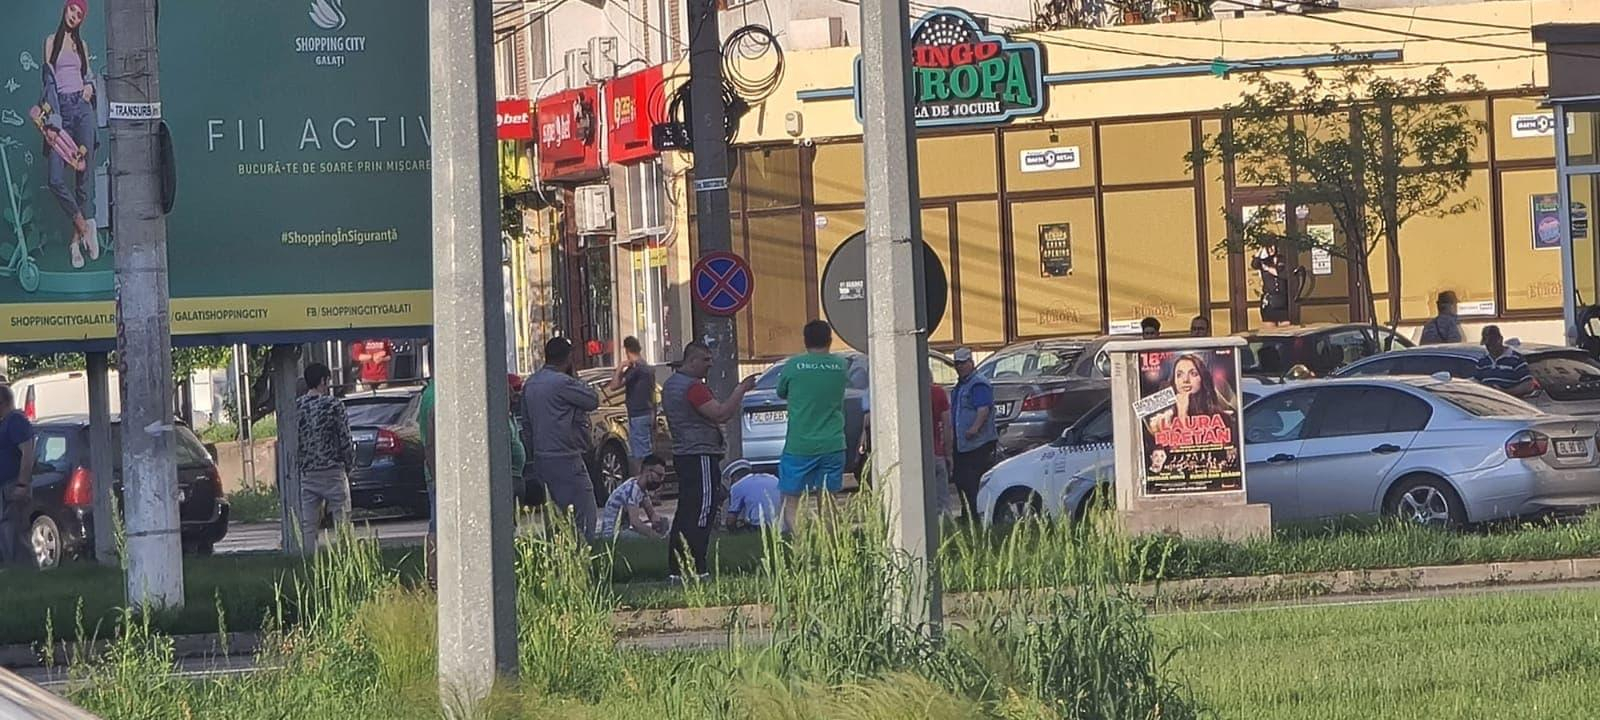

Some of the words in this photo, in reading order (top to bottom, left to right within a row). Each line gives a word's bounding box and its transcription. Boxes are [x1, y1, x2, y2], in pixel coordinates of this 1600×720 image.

[295, 37, 344, 52] SHOPPING
[345, 36, 366, 51] CITY
[914, 43, 998, 67] INGO
[913, 52, 1032, 106] ROPA
[914, 107, 930, 118] LA
[932, 105, 950, 117] DE
[952, 101, 1001, 116] JOCURI
[208, 119, 265, 151] FII
[238, 161, 299, 176] BUCURĂ-TE
[302, 163, 317, 174] DE
[319, 162, 354, 173] SOARE
[357, 161, 383, 172] PRIN
[10, 313, 117, 326] SHOPPINGCITYGALATI.R
[1160, 414, 1226, 430] LAURA
[1154, 428, 1231, 448] BRETAN
